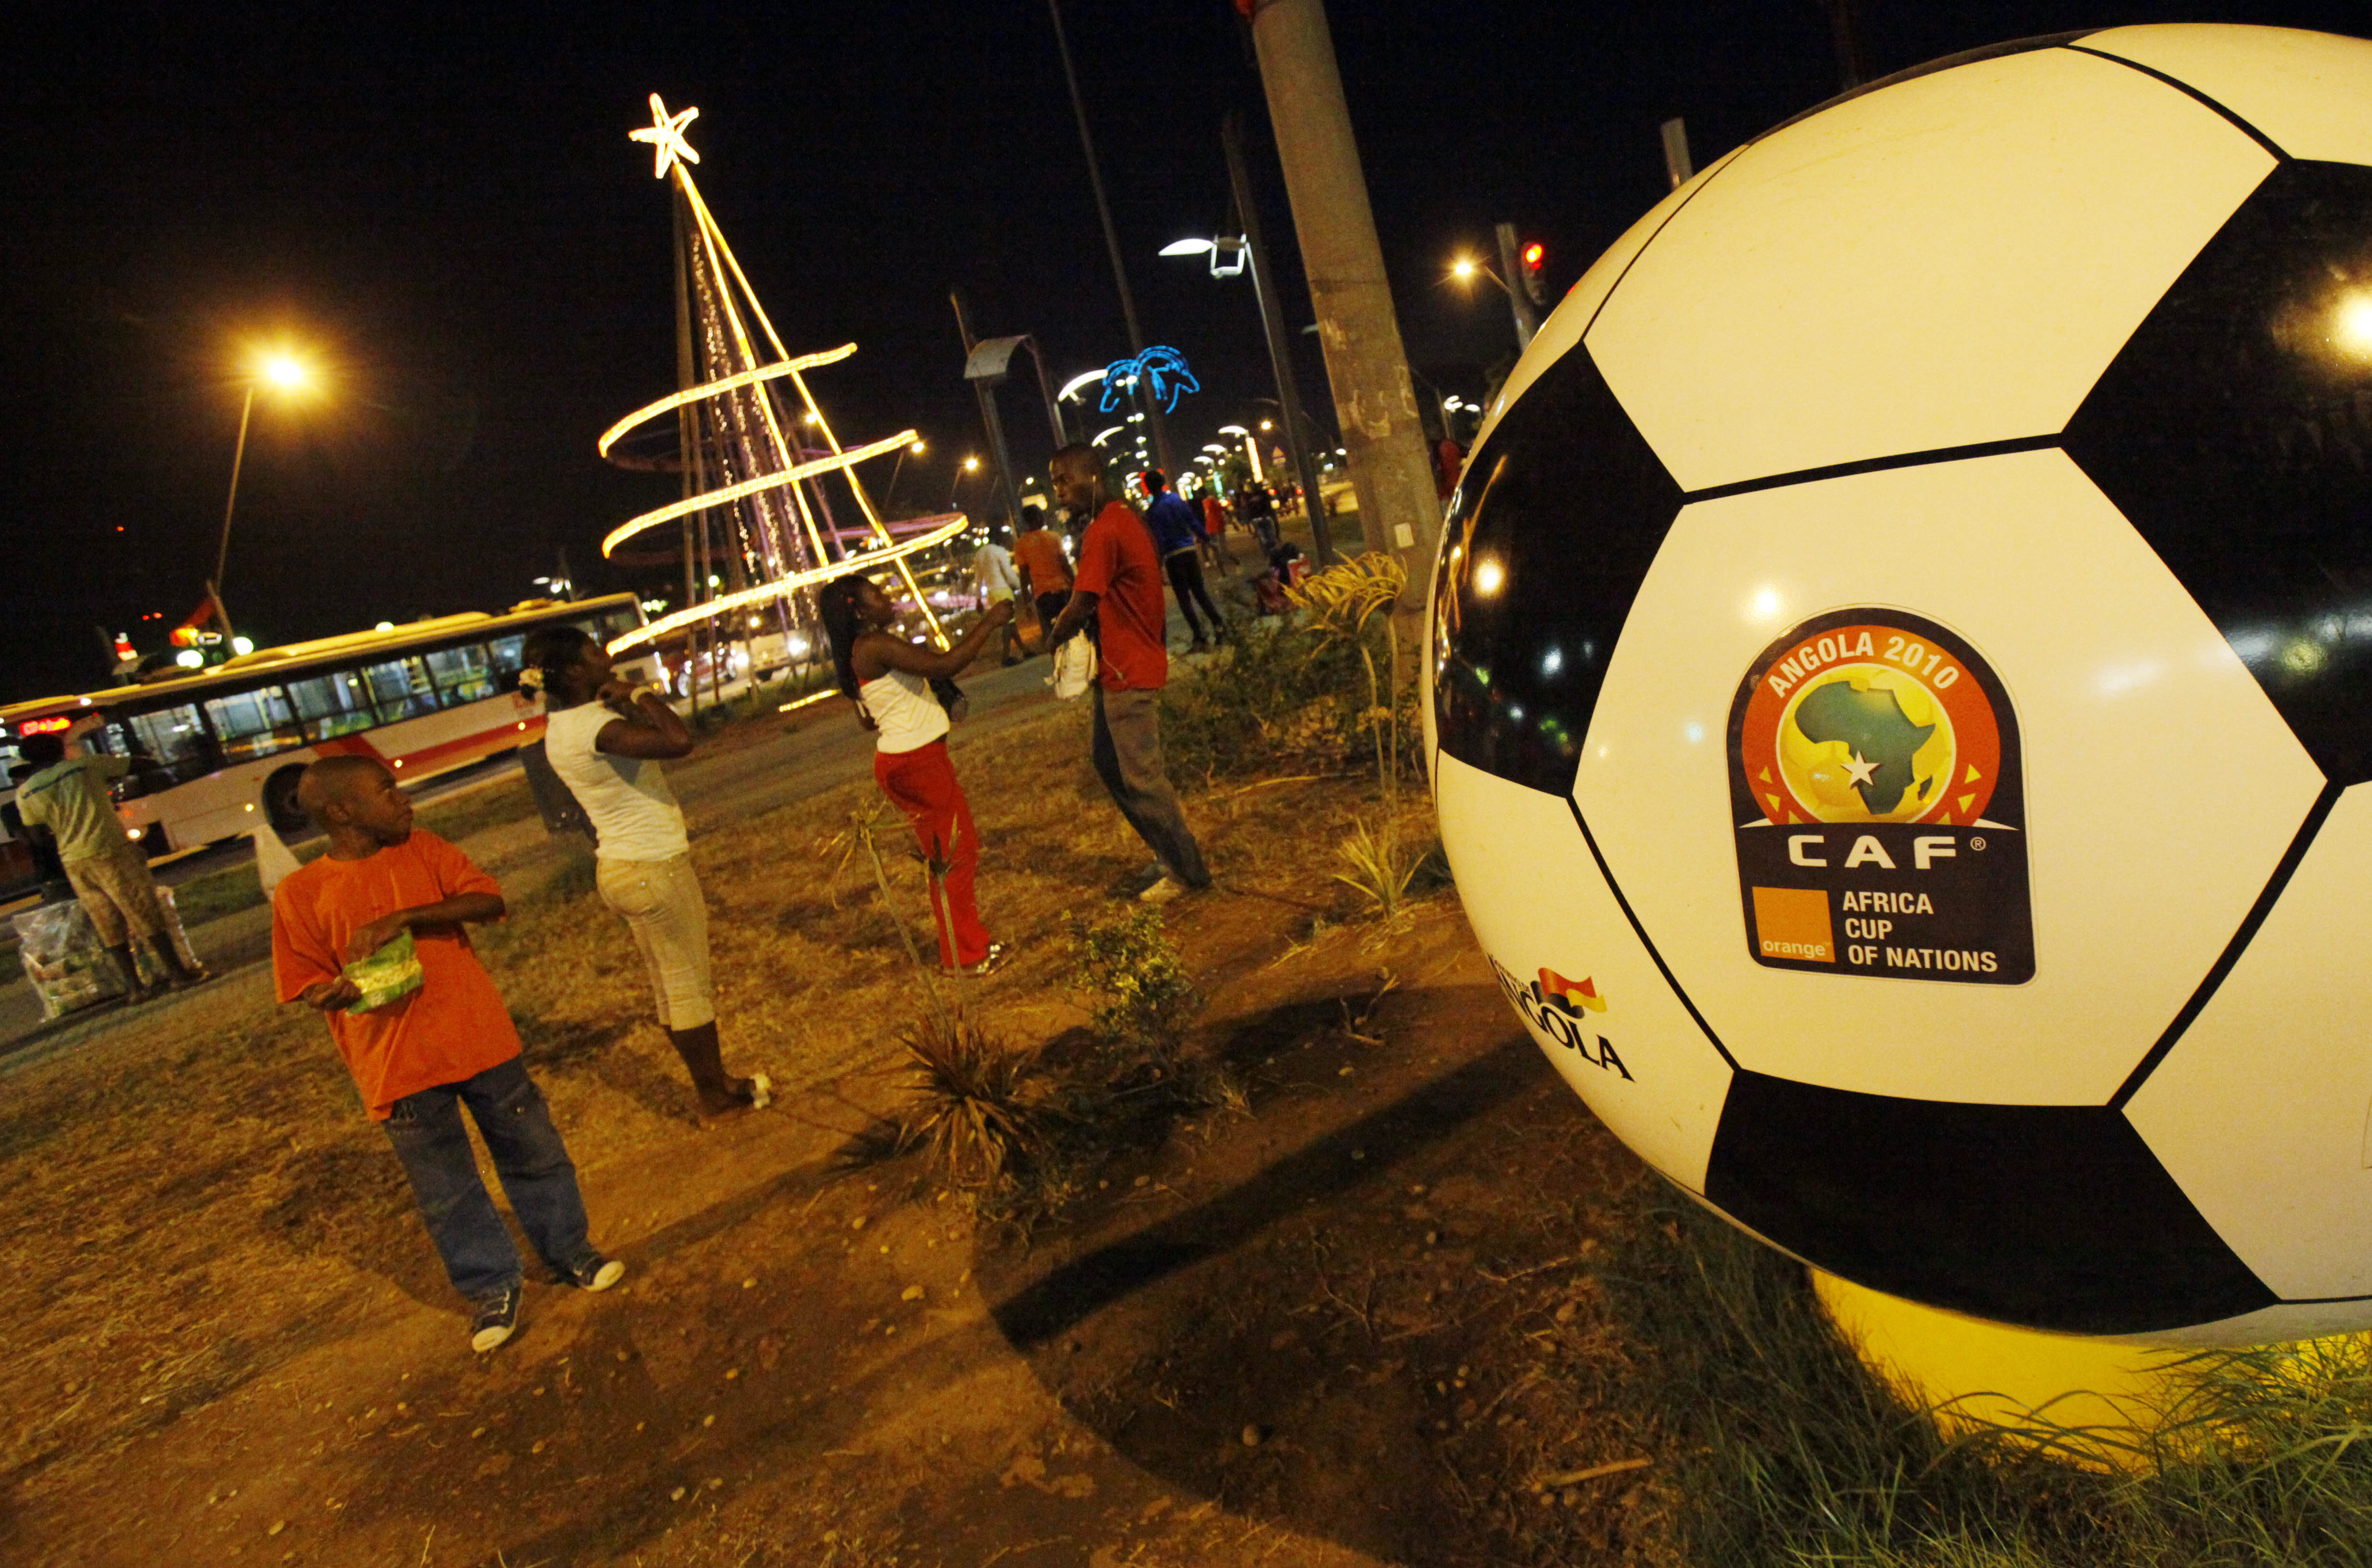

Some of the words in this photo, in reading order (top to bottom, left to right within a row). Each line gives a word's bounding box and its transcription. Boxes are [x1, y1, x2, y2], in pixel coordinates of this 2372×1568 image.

[1768, 632, 1874, 698] ANGOLA
[1884, 636, 1959, 689] 2010
[1789, 835, 1957, 869] CAF
[1843, 891, 1934, 915] AFRICA
[1845, 918, 1892, 940] CUP
[1763, 940, 1826, 958] orange
[1848, 945, 1878, 965] OF
[1887, 948, 1998, 972] NATIONS
